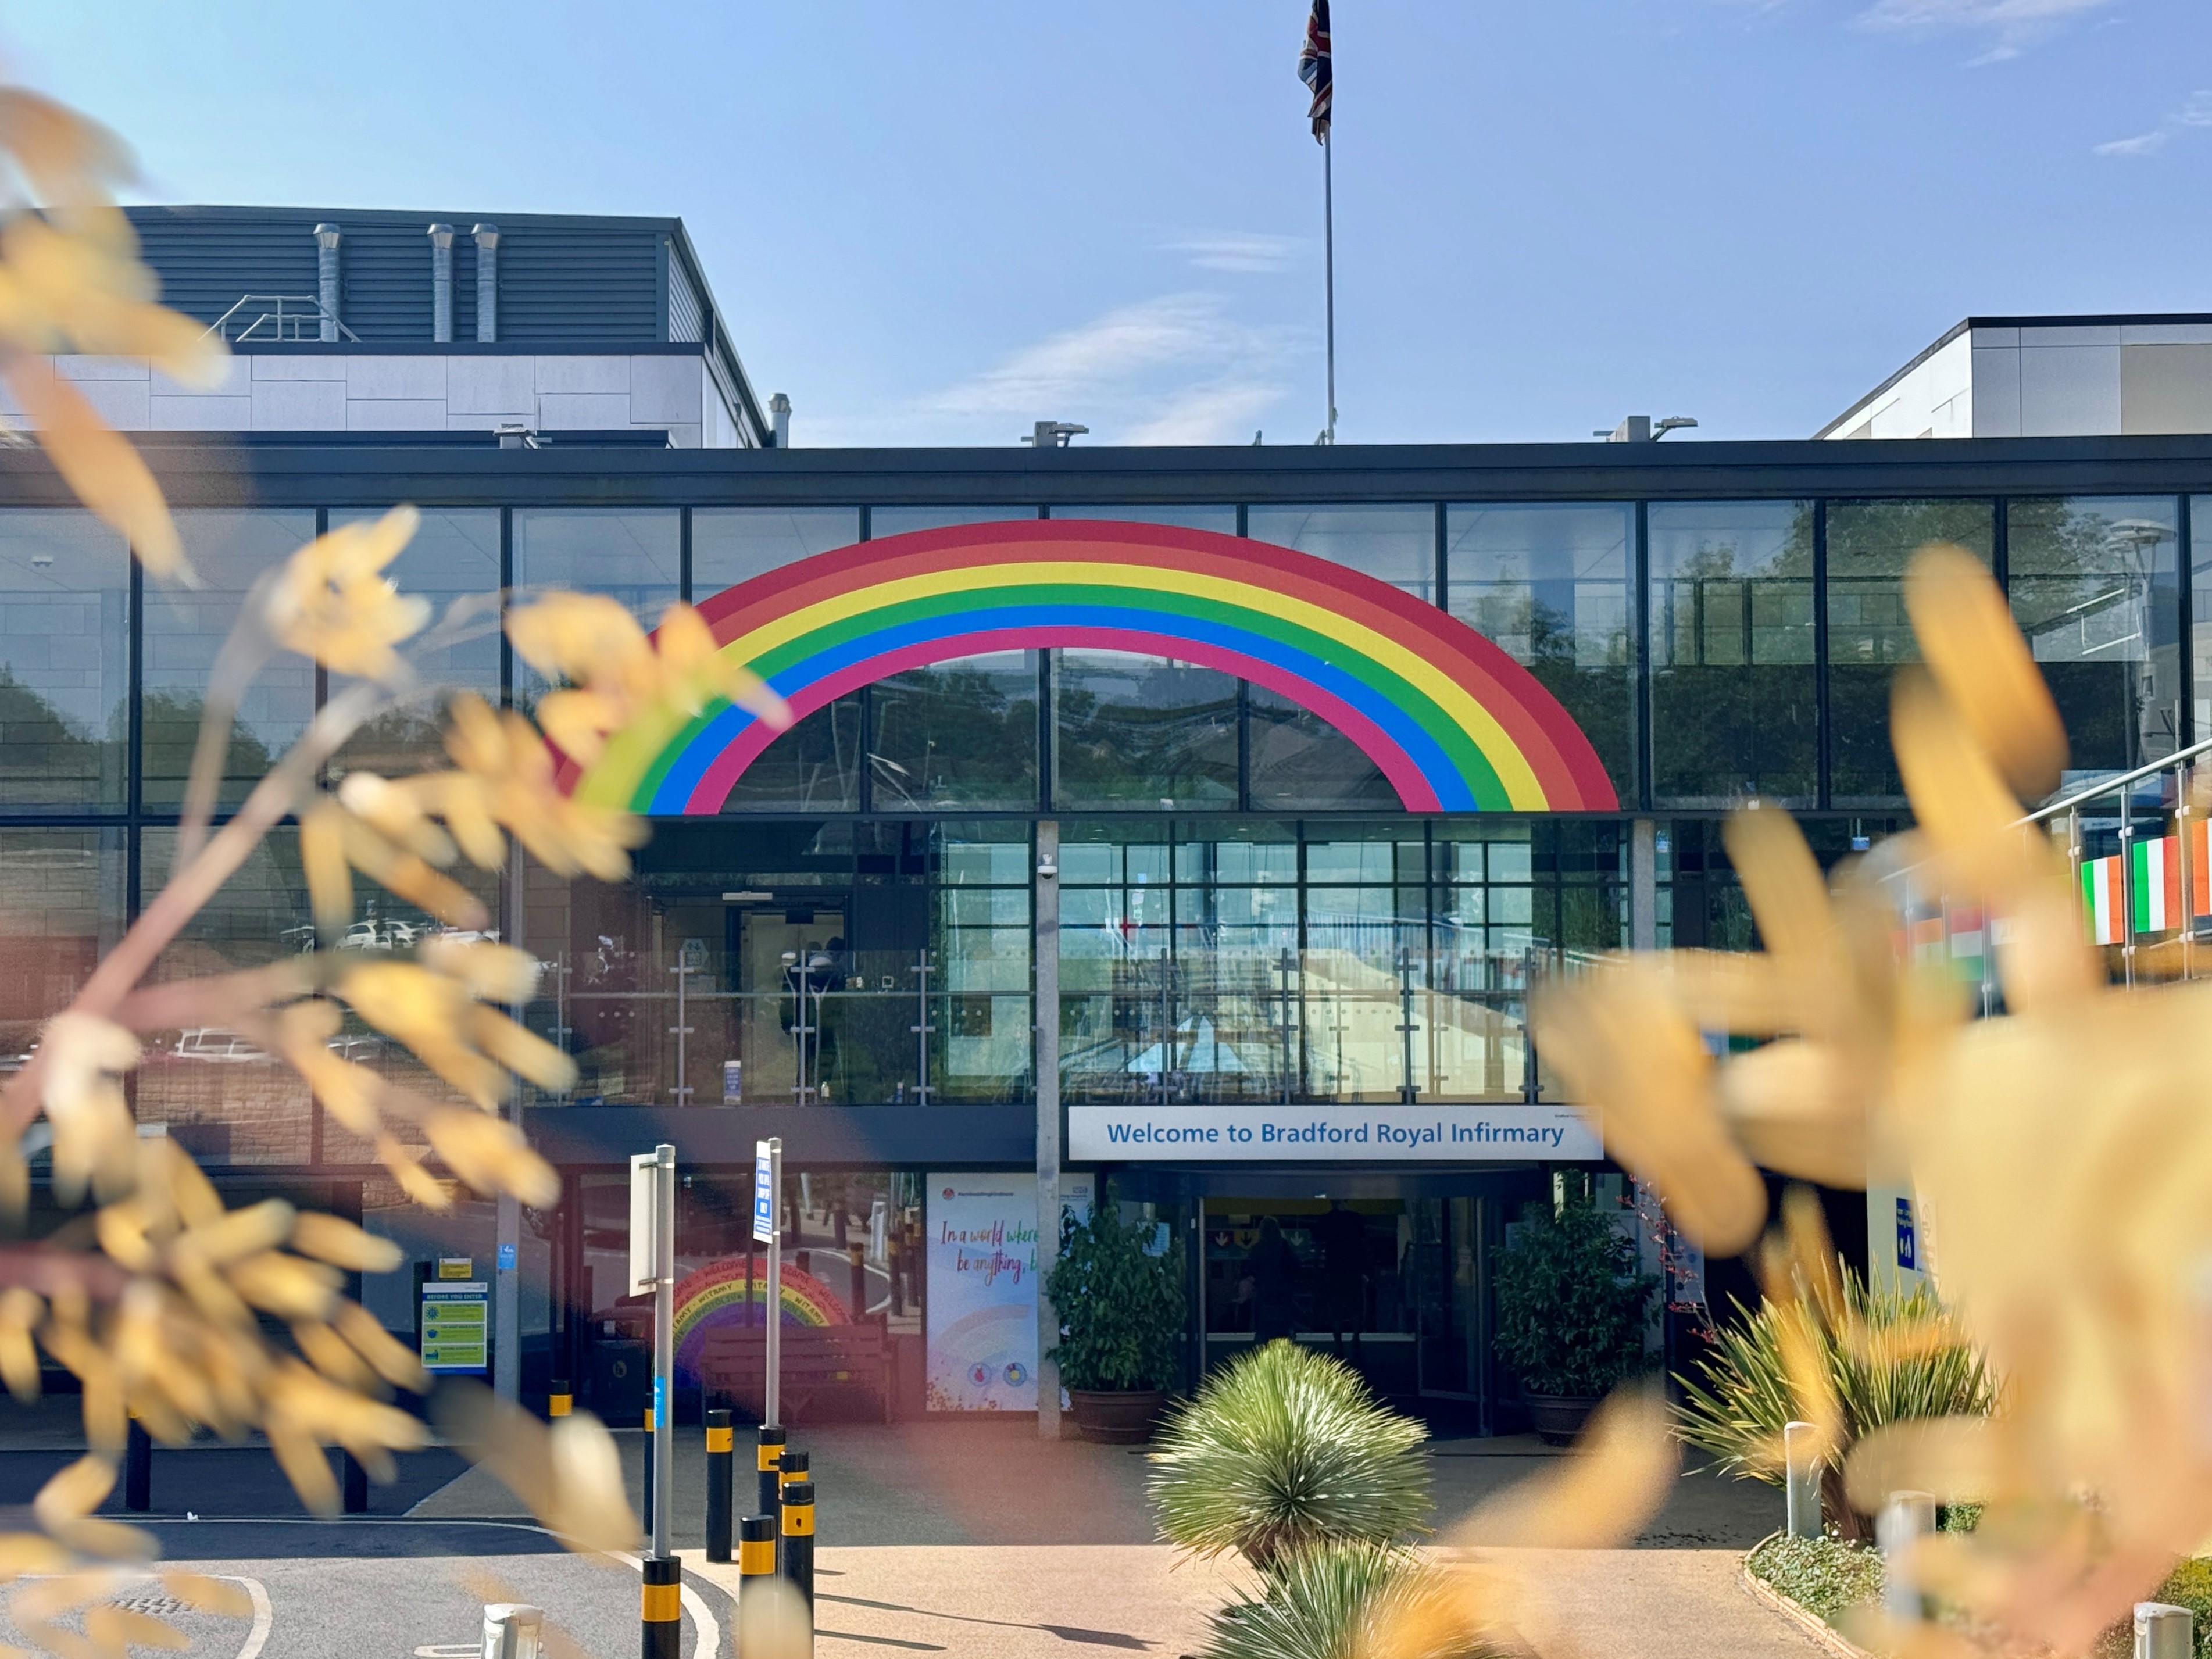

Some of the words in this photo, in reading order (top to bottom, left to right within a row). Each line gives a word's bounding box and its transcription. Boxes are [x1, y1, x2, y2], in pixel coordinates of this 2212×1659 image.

[1107, 1122, 1219, 1143] Welcome
[1227, 1124, 1252, 1143] to
[1262, 1122, 1368, 1143] Bradford
[1377, 1122, 1442, 1148] Royal
[1452, 1122, 1564, 1147] Infirmary
[970, 1220, 1005, 1246] world
[957, 1249, 970, 1272] be
[698, 1281, 733, 1303] WITAMY
[794, 1296, 826, 1324] WITAMY
